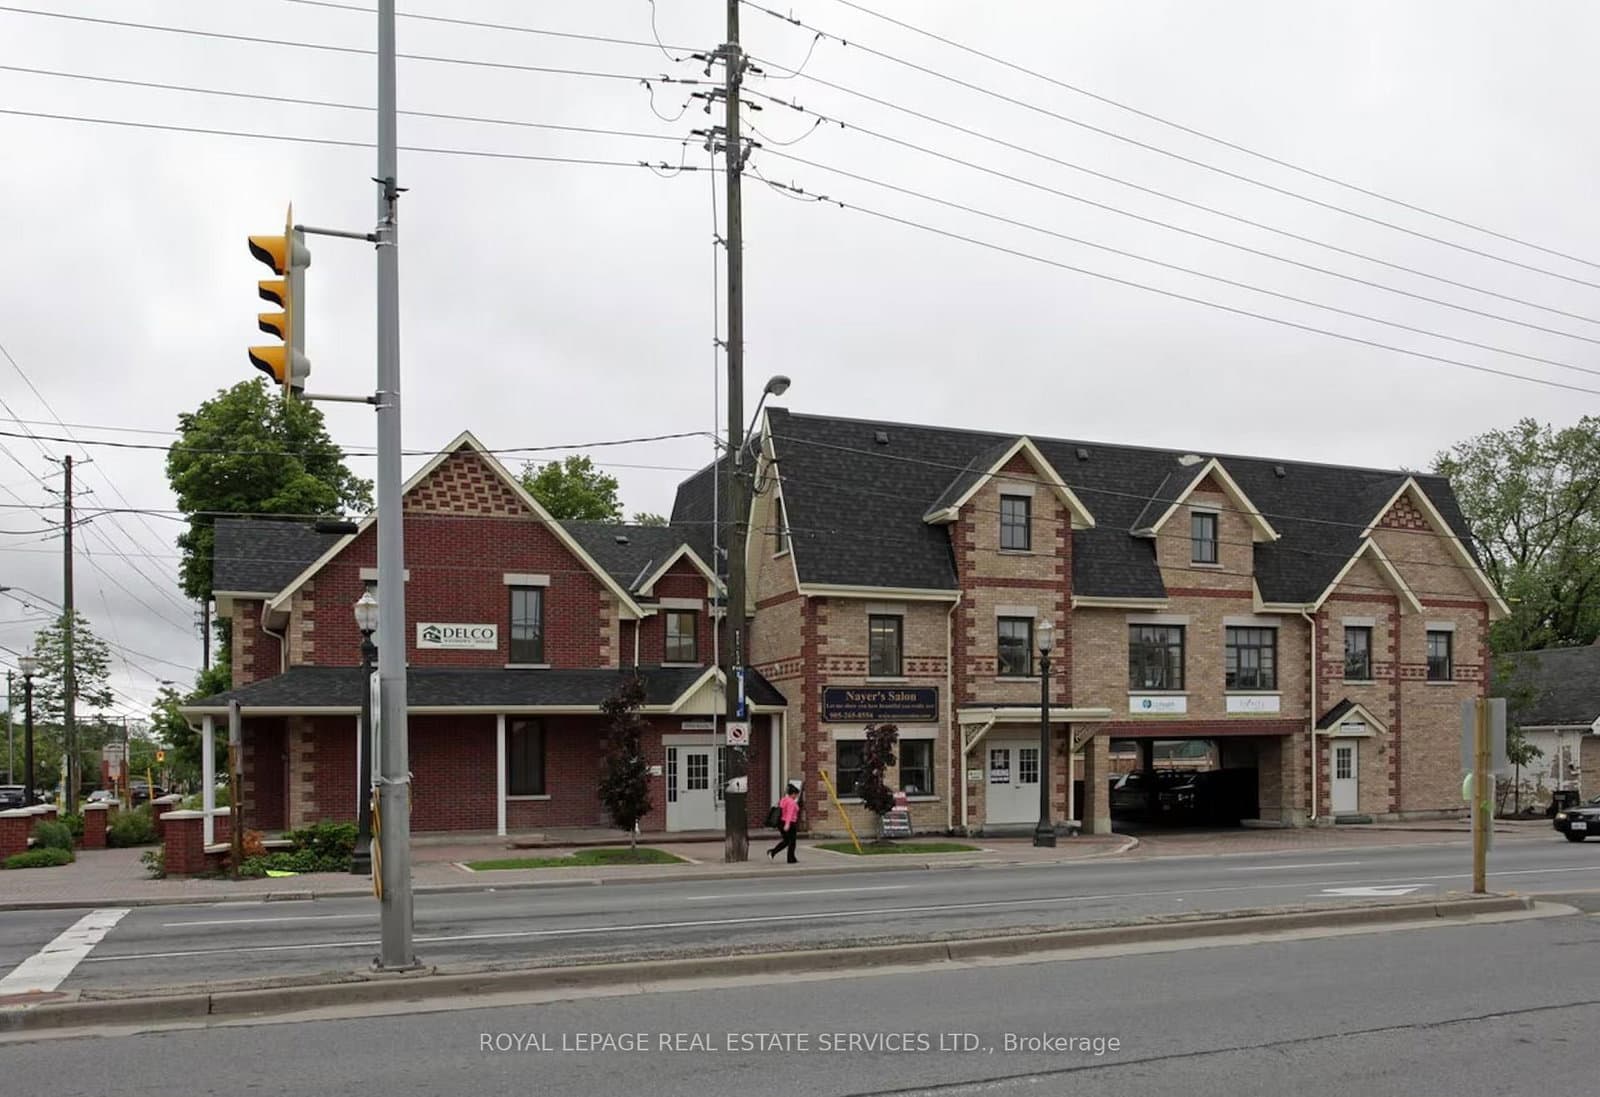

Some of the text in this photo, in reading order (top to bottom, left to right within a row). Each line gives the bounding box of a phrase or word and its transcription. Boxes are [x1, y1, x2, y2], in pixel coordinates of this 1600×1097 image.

[443, 628, 494, 639] DELCO
[846, 691, 917, 703] Nayer's Salon
